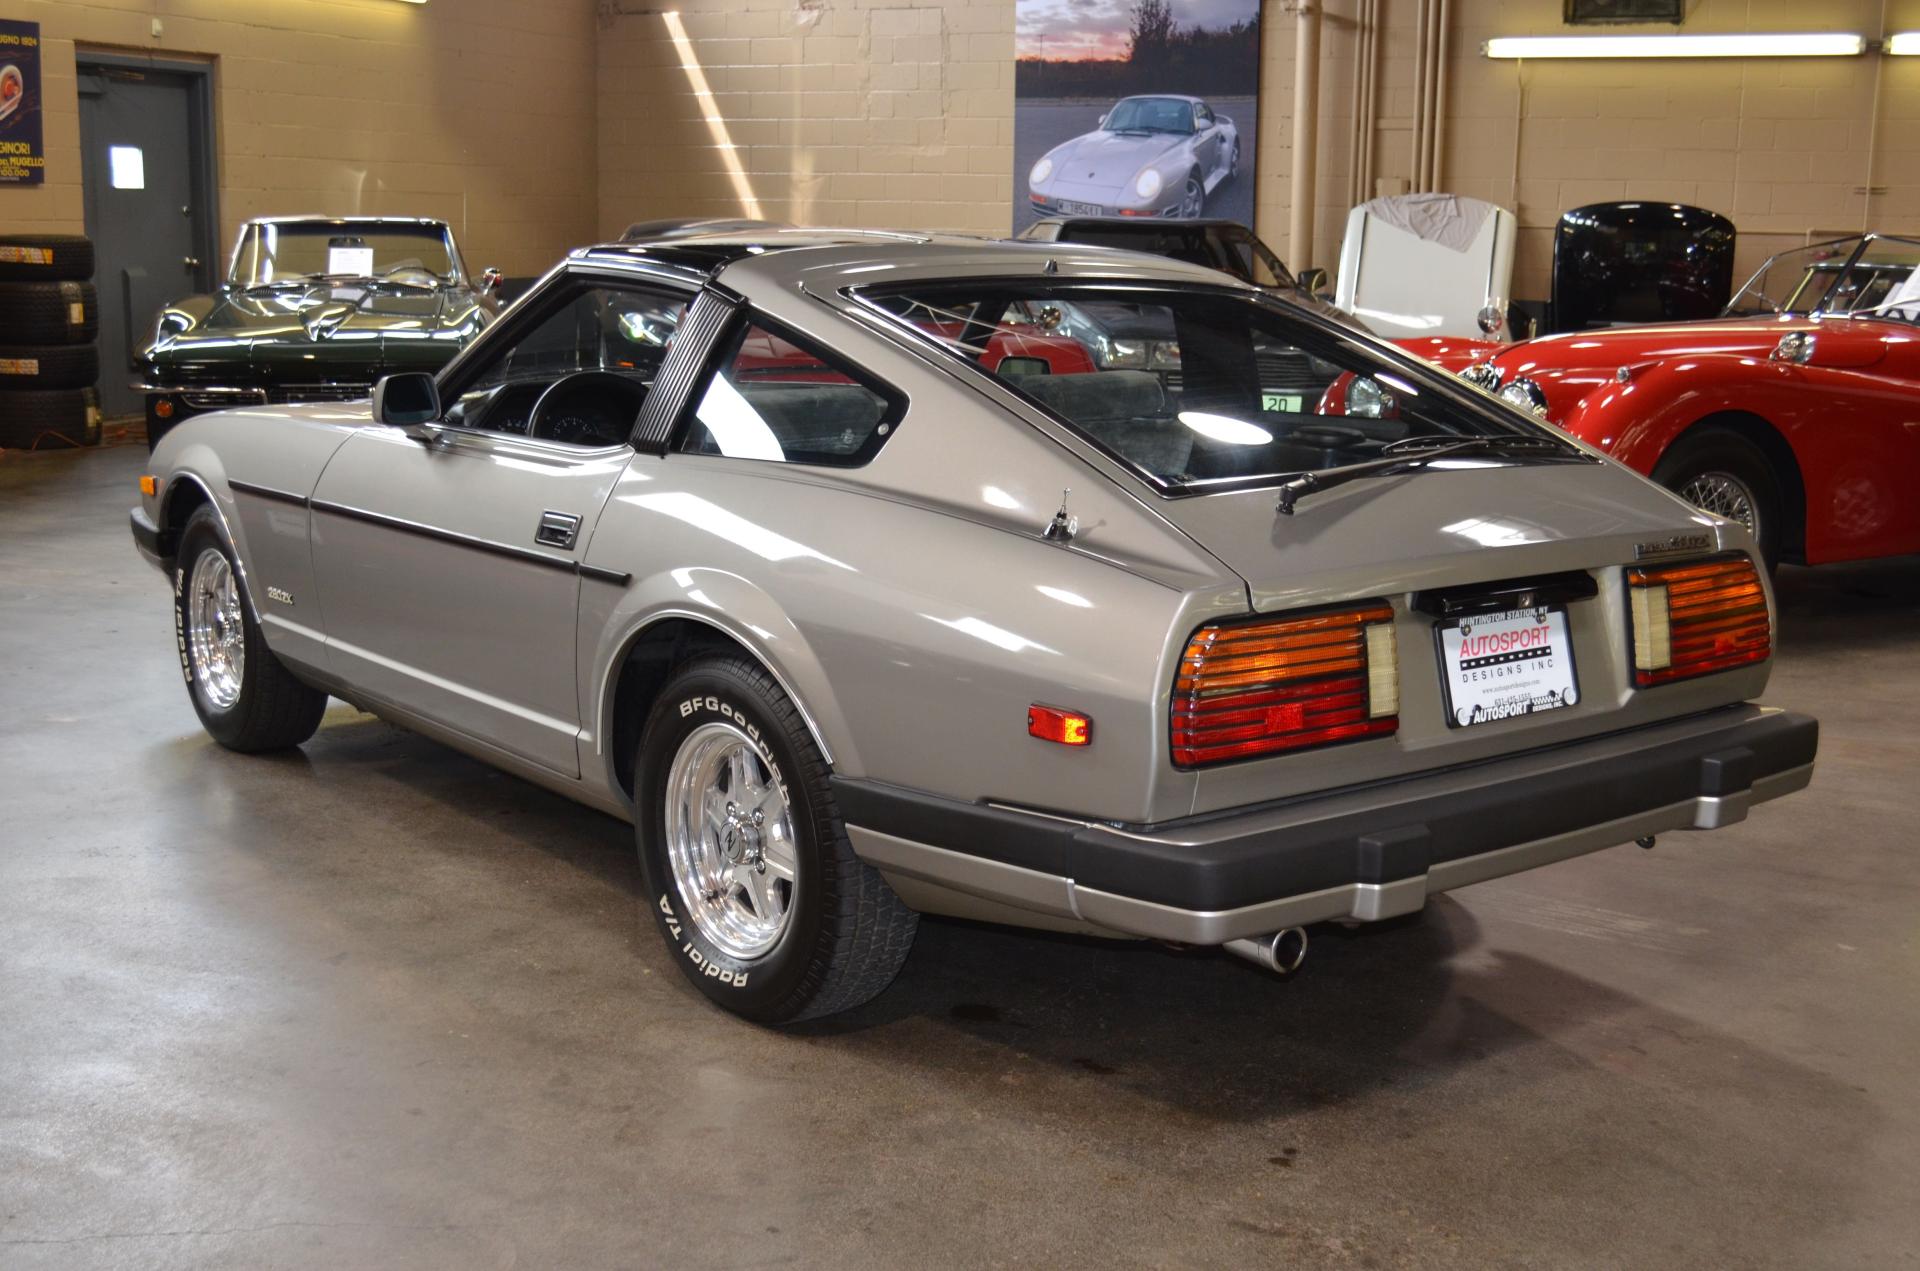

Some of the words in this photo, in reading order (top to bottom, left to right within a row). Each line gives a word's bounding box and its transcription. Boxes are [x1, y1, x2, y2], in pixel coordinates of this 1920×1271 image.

[1459, 613, 1506, 627] HUNTINGTON
[1460, 626, 1550, 658] AUTOSPORT
[1463, 664, 1522, 682] DESIGNS
[1532, 659, 1554, 671] INC
[1473, 701, 1529, 724] AUTOSPORT
[659, 894, 683, 940] T/A
[683, 942, 749, 988] Radial
